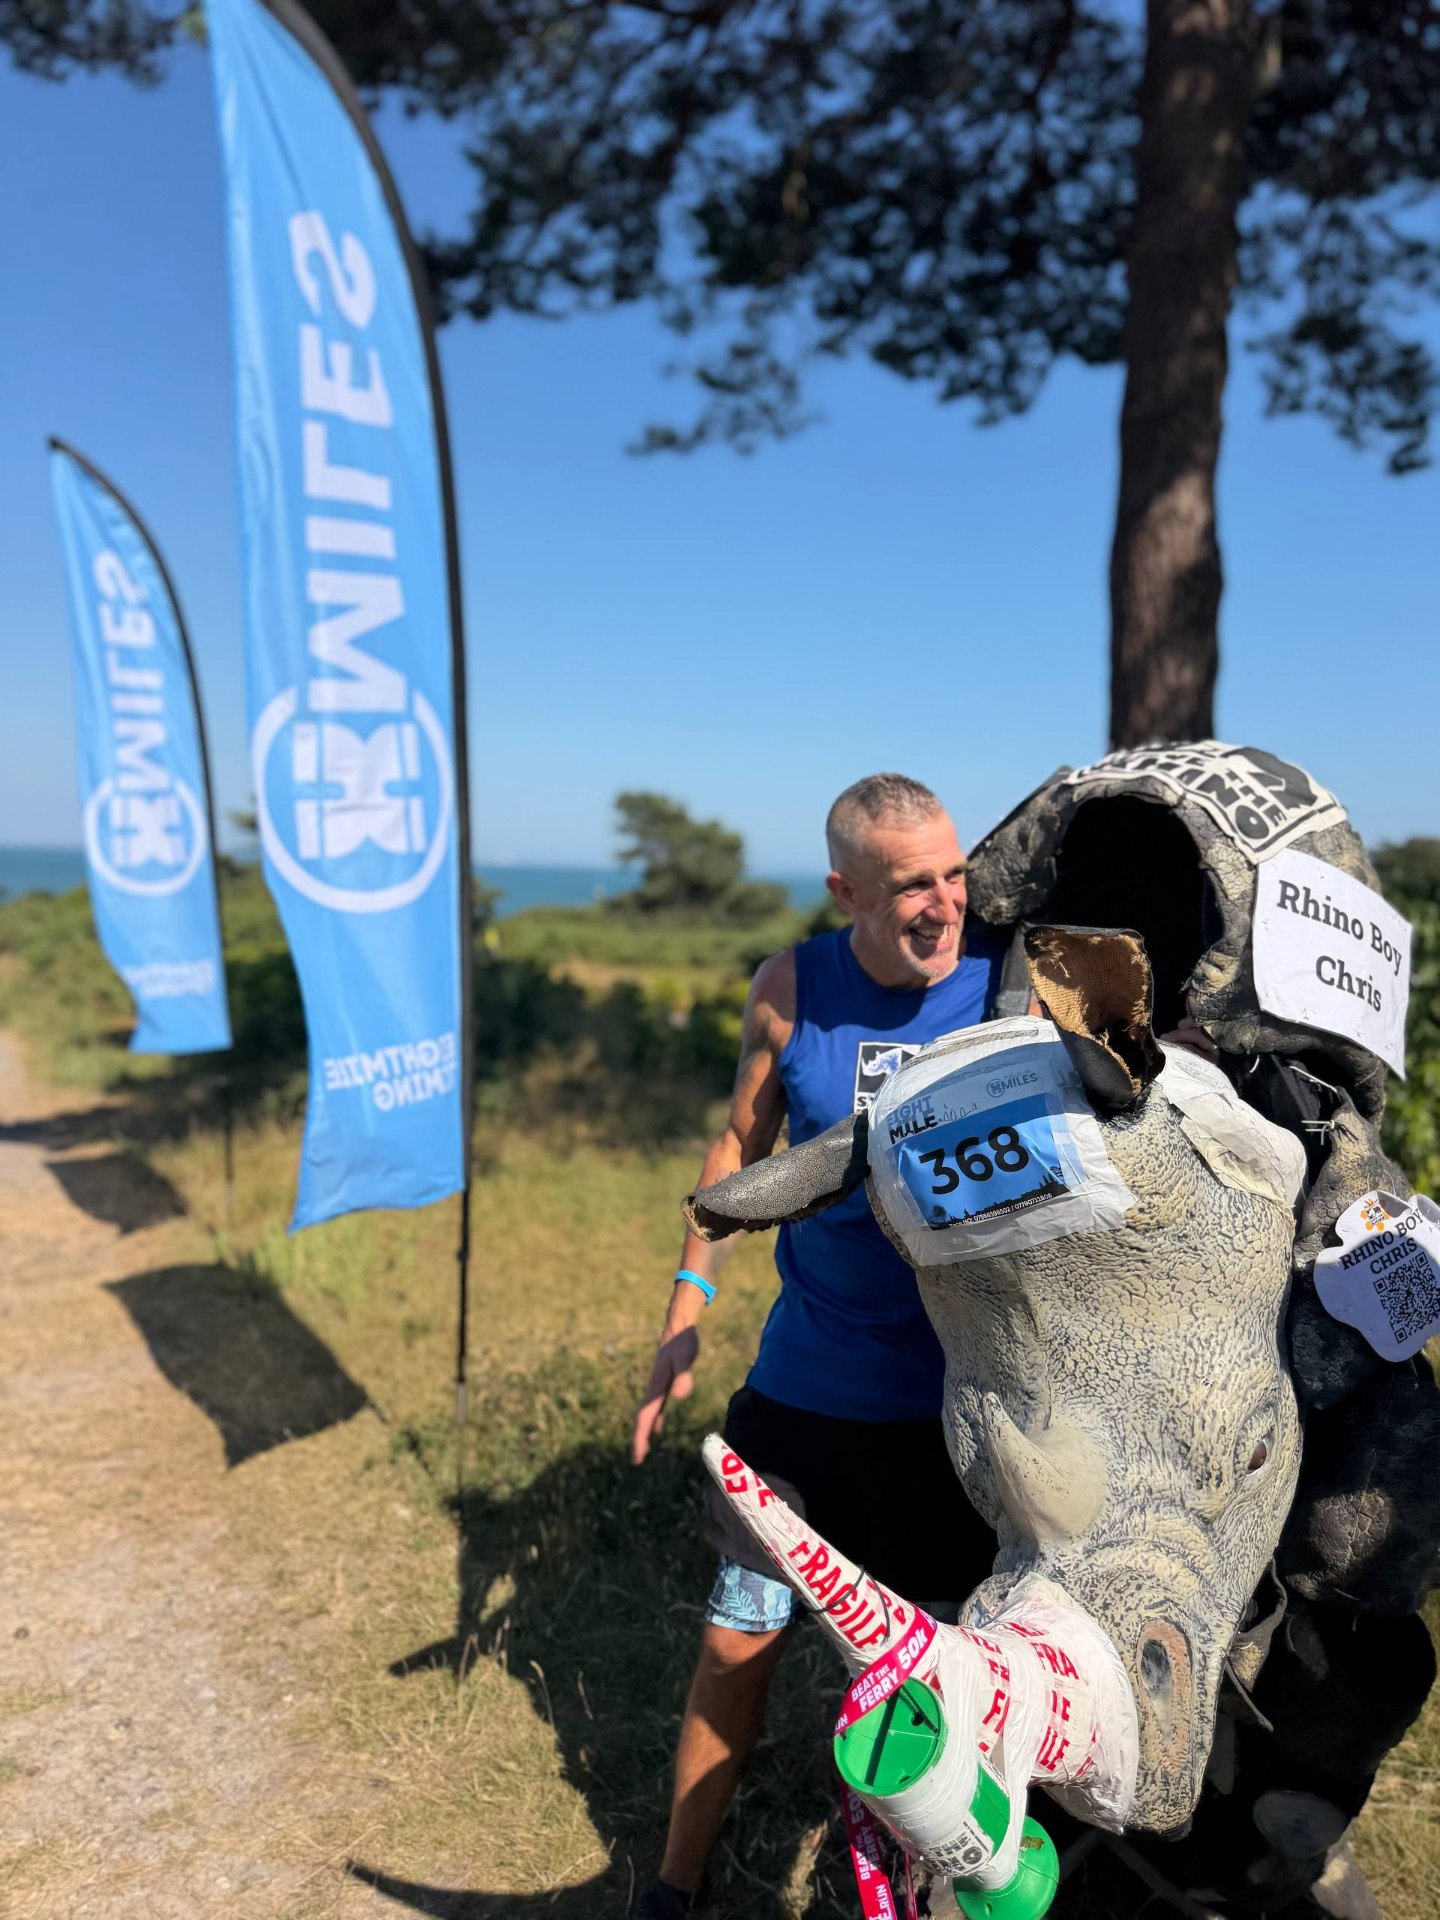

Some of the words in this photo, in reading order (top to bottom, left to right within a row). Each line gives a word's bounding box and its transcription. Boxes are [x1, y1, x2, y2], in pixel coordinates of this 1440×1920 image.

[1276, 879, 1364, 941] Rhino
[1369, 921, 1402, 977] Boy
[1315, 955, 1382, 1012] Chris
[889, 1115, 938, 1144] MILE
[918, 1125, 1029, 1195] 368
[1339, 1230, 1394, 1270] RHINO
[1394, 1208, 1424, 1238] BOY
[1369, 1238, 1418, 1274] CHRIS
[851, 1671, 874, 1702] BEAT
[874, 1663, 890, 1680] THE
[858, 1668, 899, 1712] FERRY
